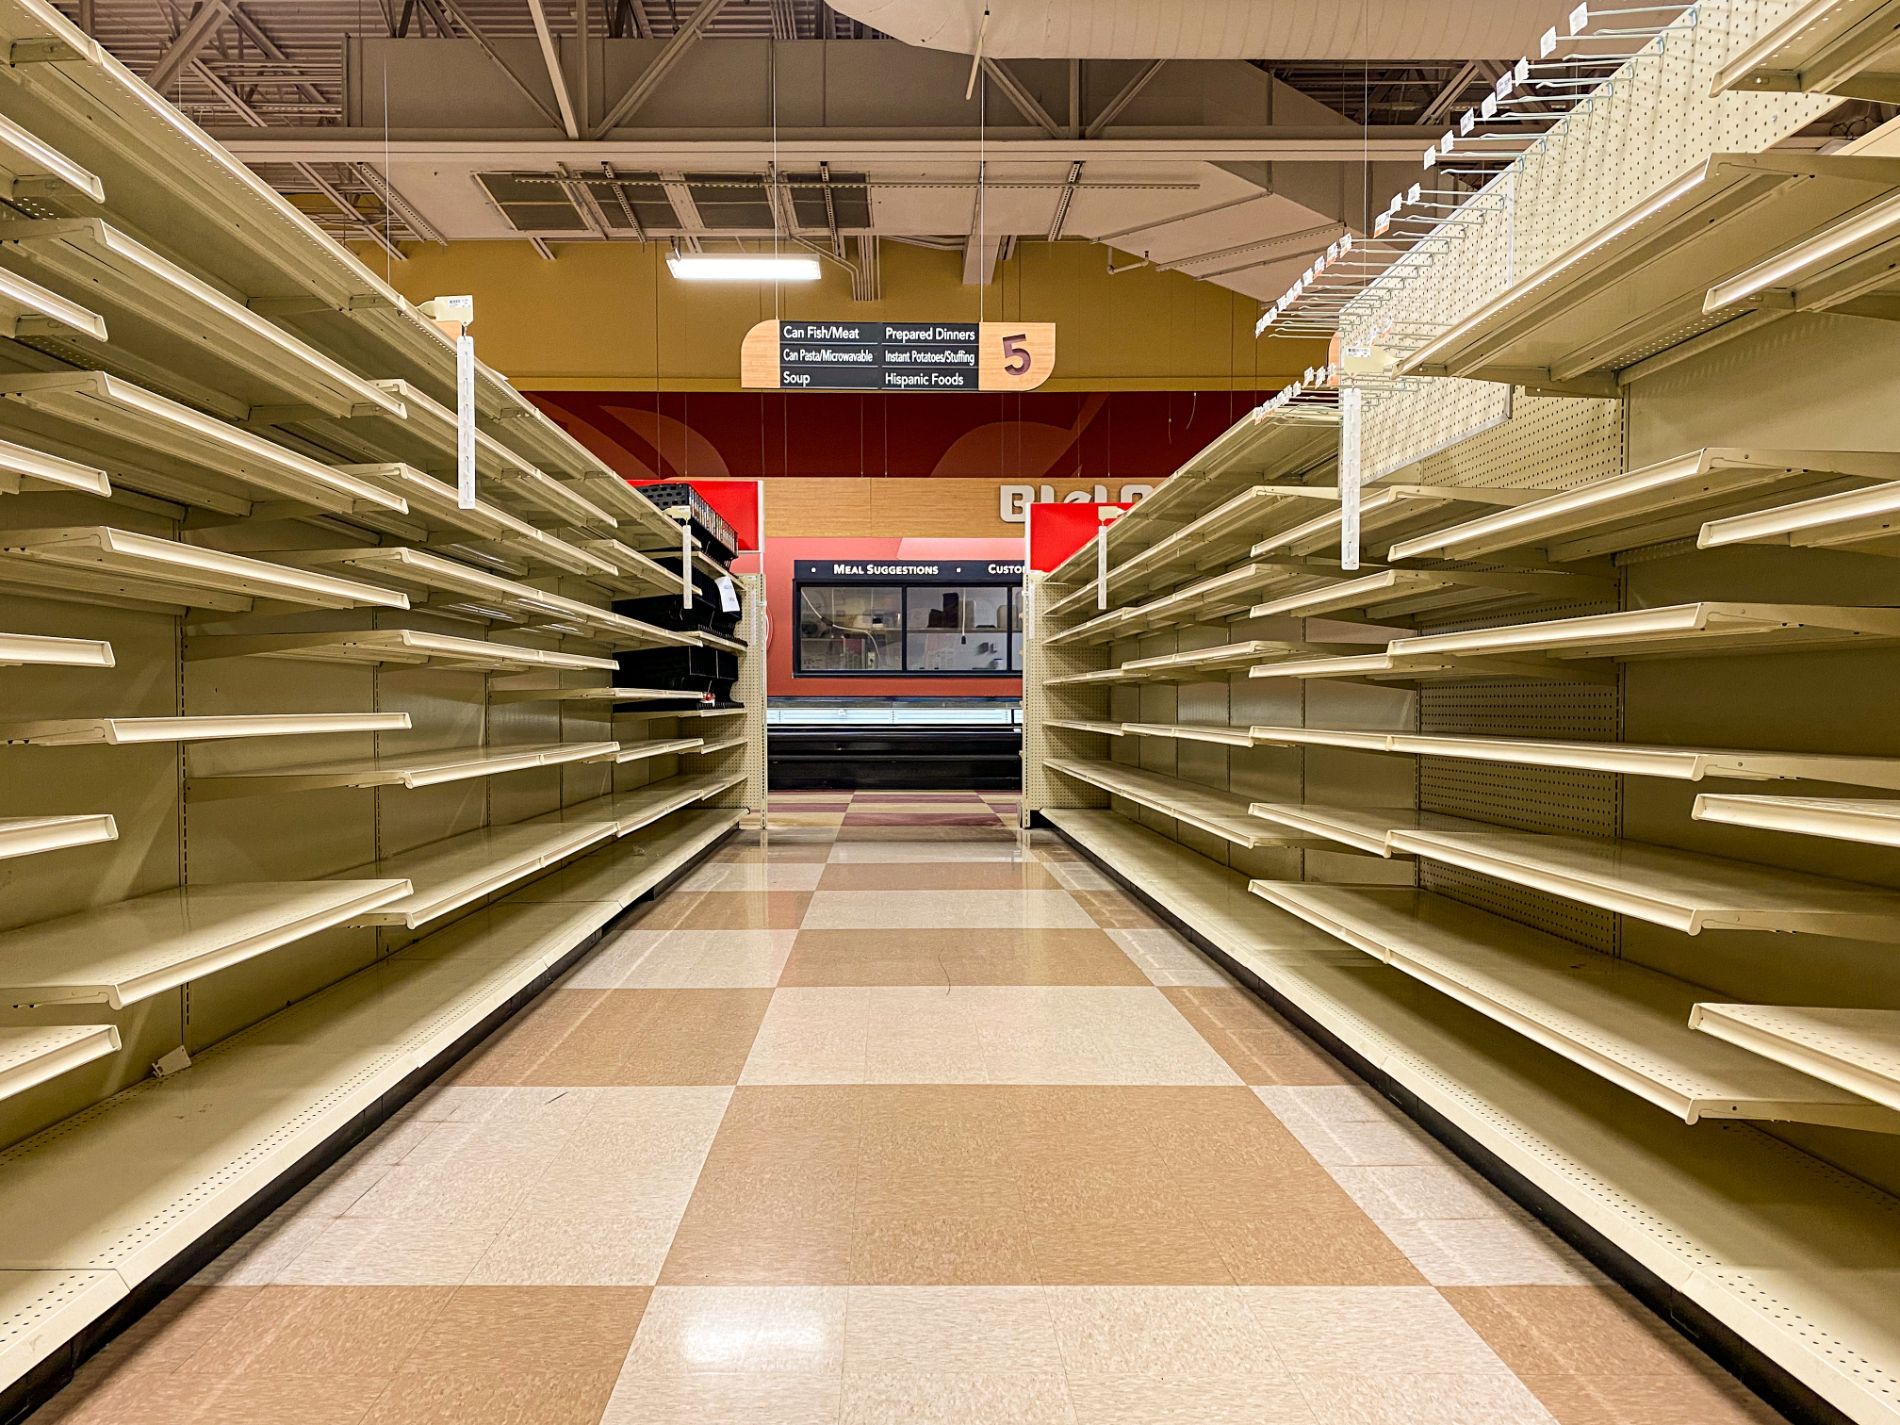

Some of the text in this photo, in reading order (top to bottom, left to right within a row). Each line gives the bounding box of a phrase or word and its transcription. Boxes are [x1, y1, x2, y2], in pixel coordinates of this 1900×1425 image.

[783, 325, 860, 339] Can Fish/Meat
[885, 327, 976, 344] Prepared Dinners
[783, 348, 873, 362] Can Pasta/Microwavable
[885, 350, 975, 366] Instant Potatoes/Stuffing
[1002, 333, 1031, 375] 5
[783, 371, 811, 387] Soup
[885, 372, 964, 388] Hispanic Foods
[833, 563, 939, 575] MEAL SUGGESTIONS
